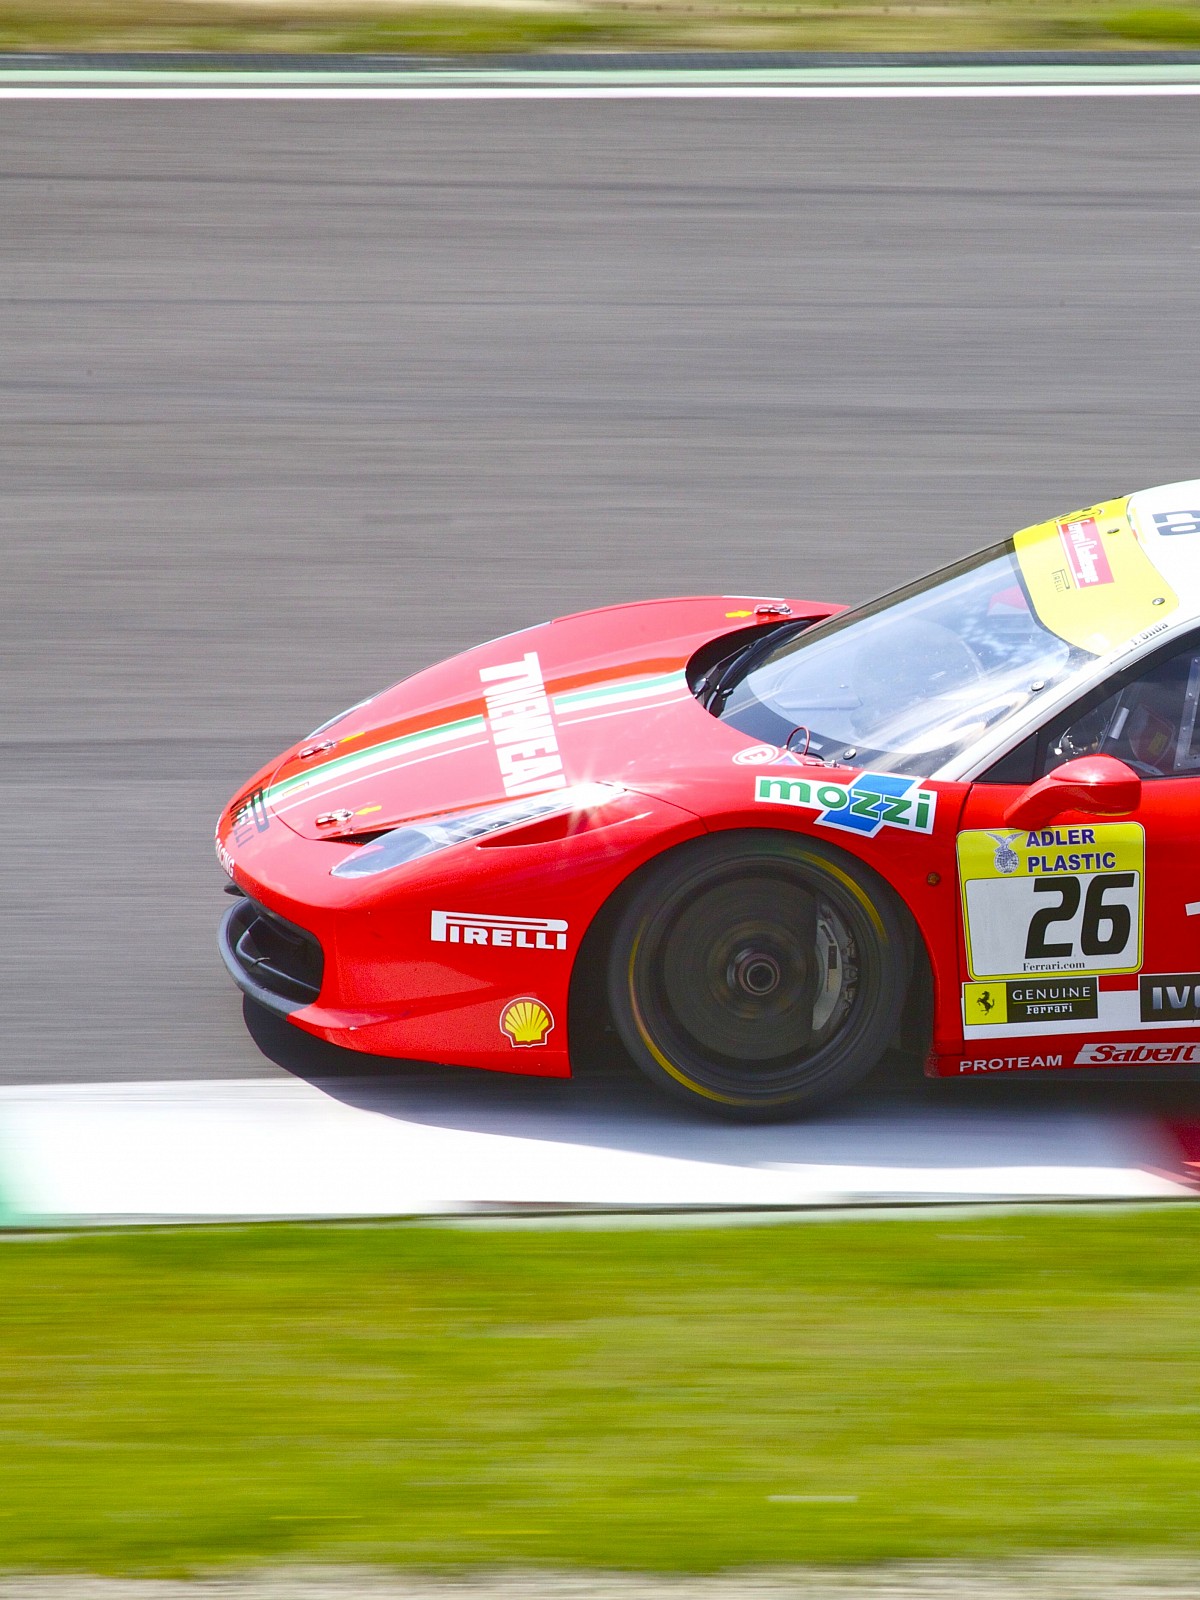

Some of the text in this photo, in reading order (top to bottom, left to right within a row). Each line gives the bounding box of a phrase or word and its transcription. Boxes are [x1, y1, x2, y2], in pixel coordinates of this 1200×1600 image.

[759, 779, 931, 829] mozzi
[1026, 828, 1096, 848] ADLER
[1027, 852, 1116, 873] PLASTIC
[1024, 873, 1135, 959] 26
[430, 910, 569, 951] PIRELLI
[1022, 960, 1086, 972] Ferrari.com
[1012, 986, 1091, 1001] GENUINE
[1026, 1003, 1073, 1015] Ferrari
[1089, 1043, 1194, 1063] Sabelt
[959, 1055, 1063, 1073] PROTEAM
